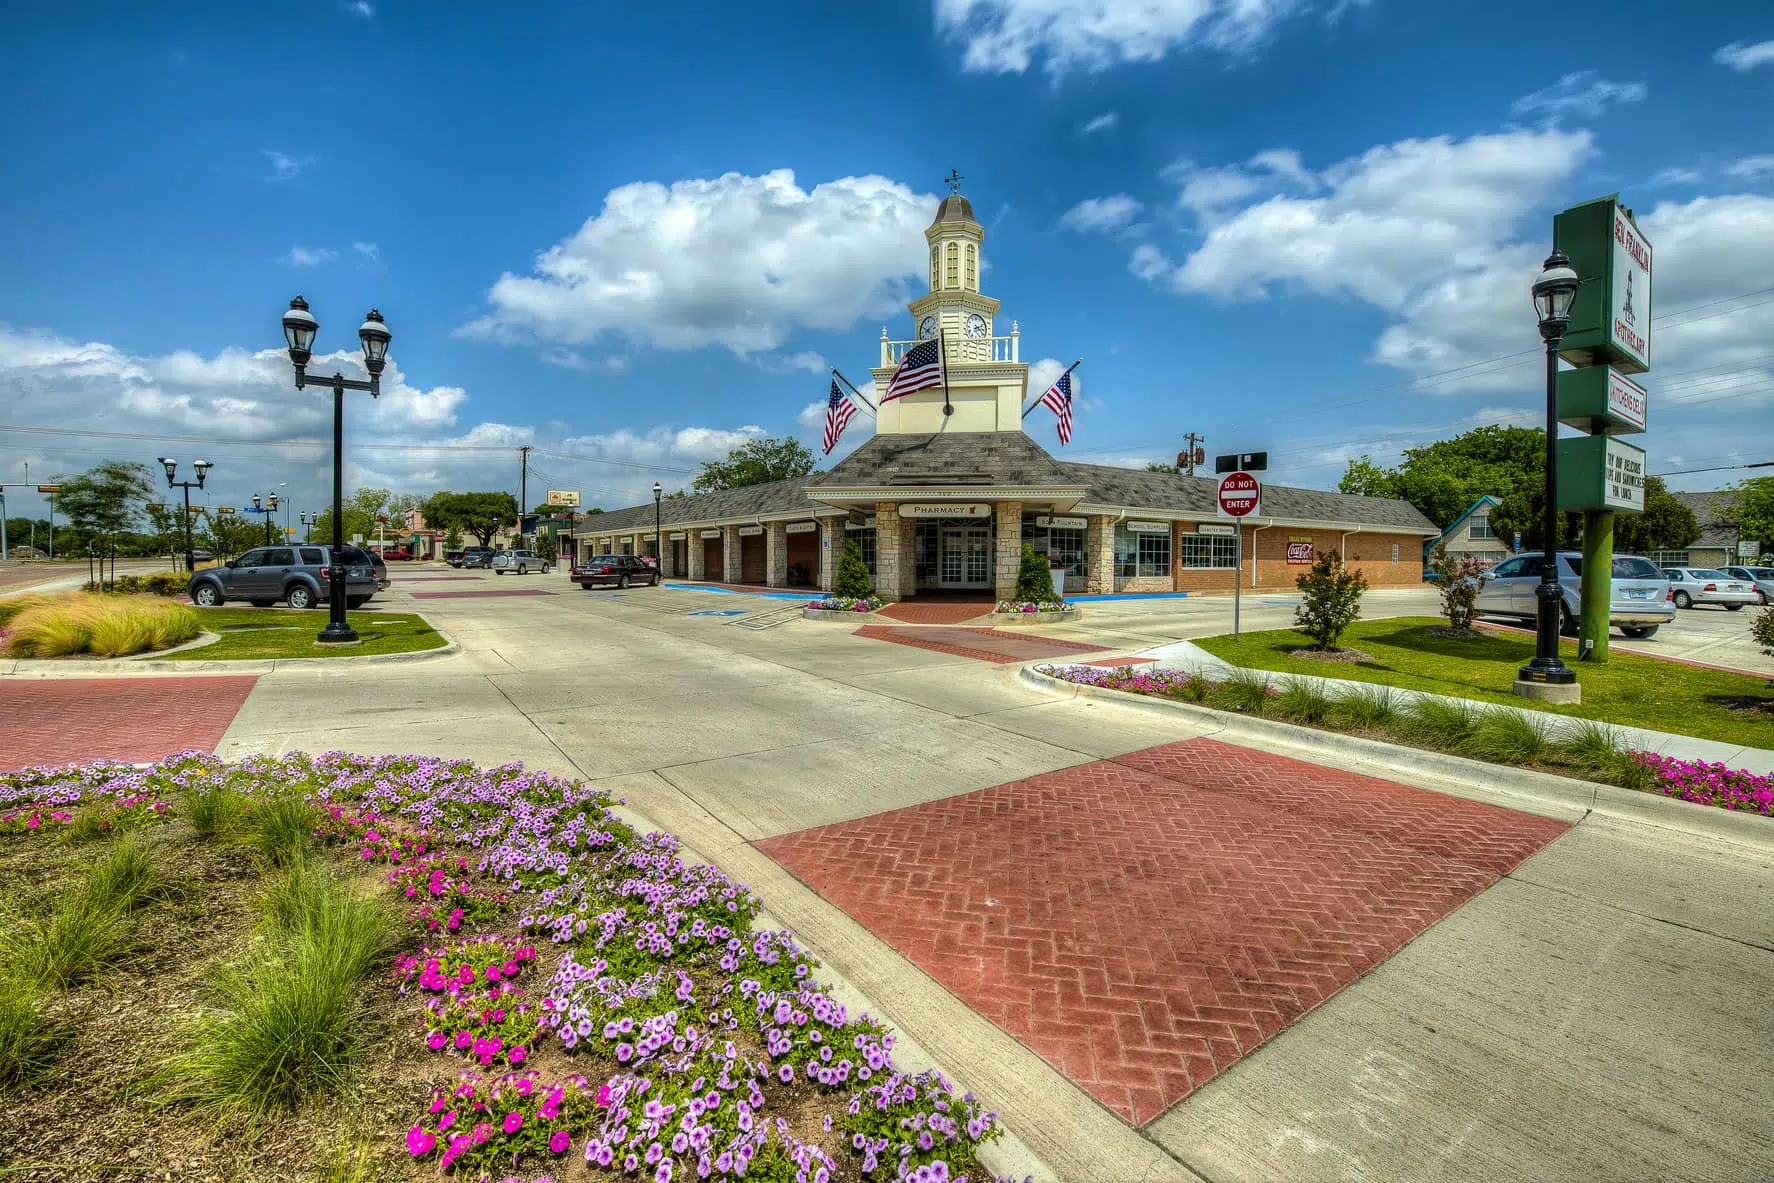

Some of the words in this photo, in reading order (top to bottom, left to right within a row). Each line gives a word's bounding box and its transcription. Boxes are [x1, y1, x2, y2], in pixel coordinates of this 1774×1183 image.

[1615, 216, 1625, 247] BEN
[1625, 230, 1649, 274] FRANKLIN
[1614, 316, 1645, 359] APOTHECARY
[1224, 481, 1235, 489] DO
[1238, 480, 1254, 489] NOT
[1226, 500, 1250, 509] ENTER
[914, 506, 965, 514] PHARMACY
